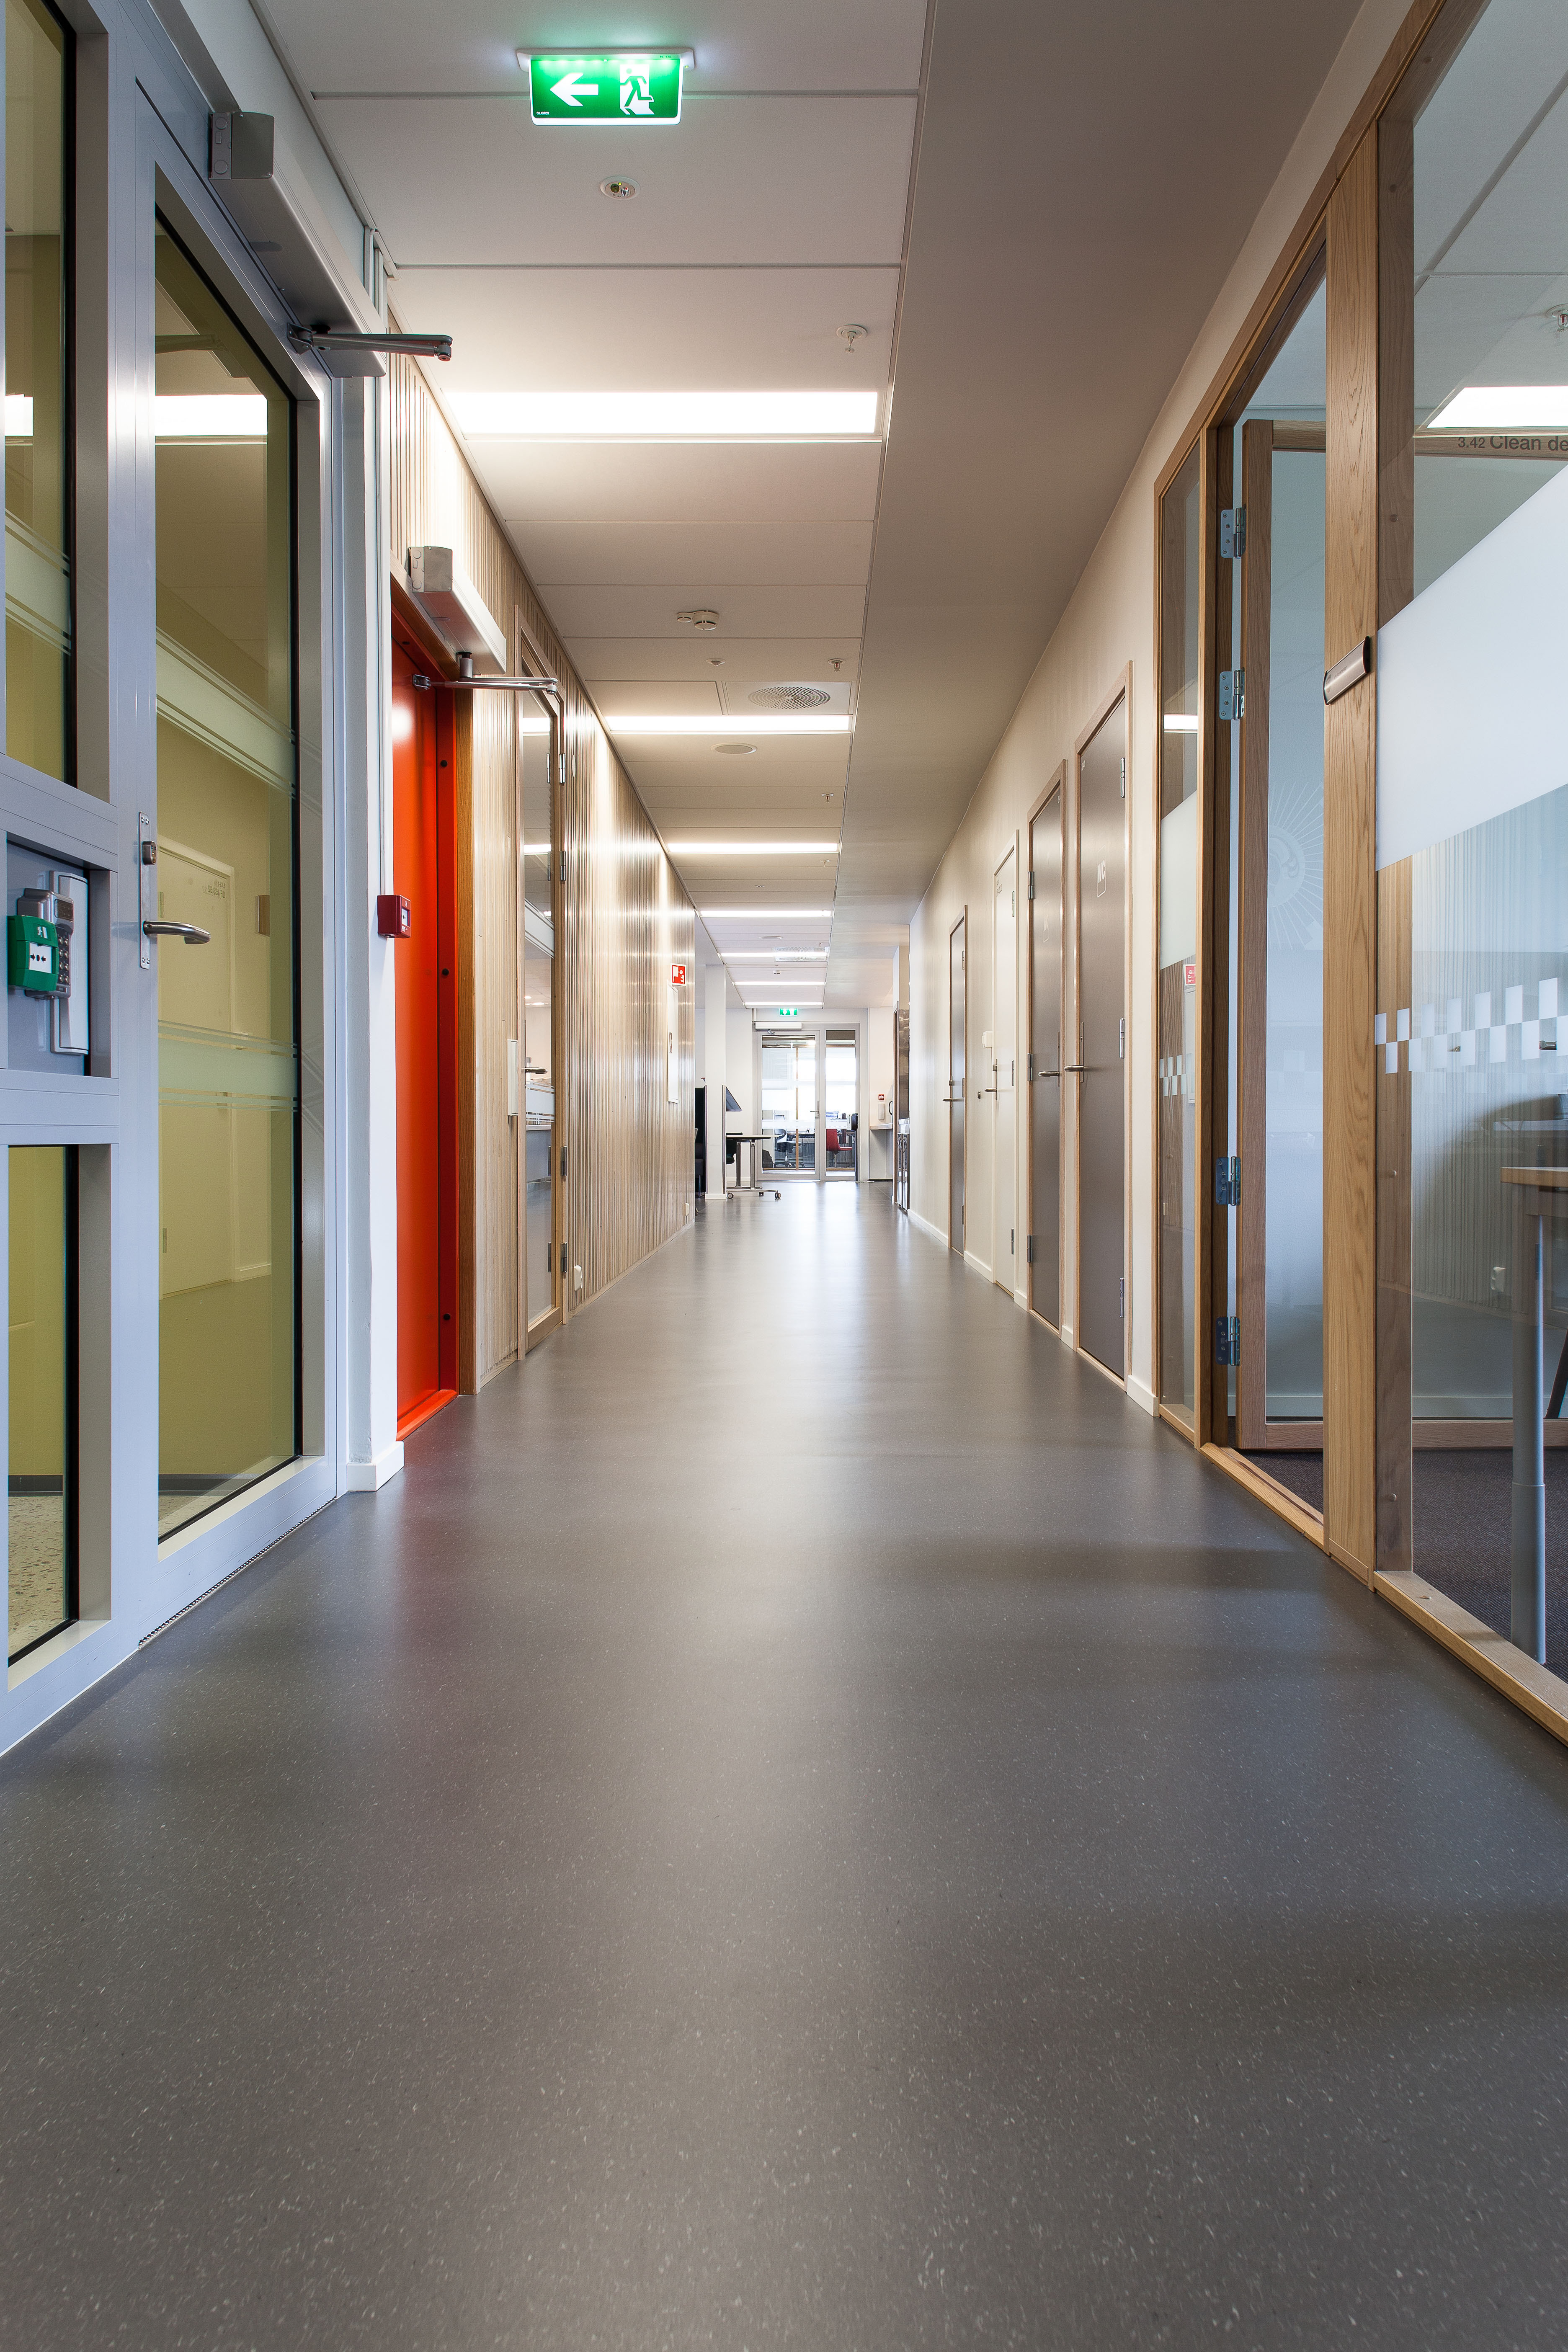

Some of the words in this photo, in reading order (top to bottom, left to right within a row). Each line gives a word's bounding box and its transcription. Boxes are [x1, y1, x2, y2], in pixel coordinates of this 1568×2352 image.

[1458, 436, 1485, 448] 3.42
[1490, 436, 1541, 450] Clean
[1098, 860, 1105, 883] WC
